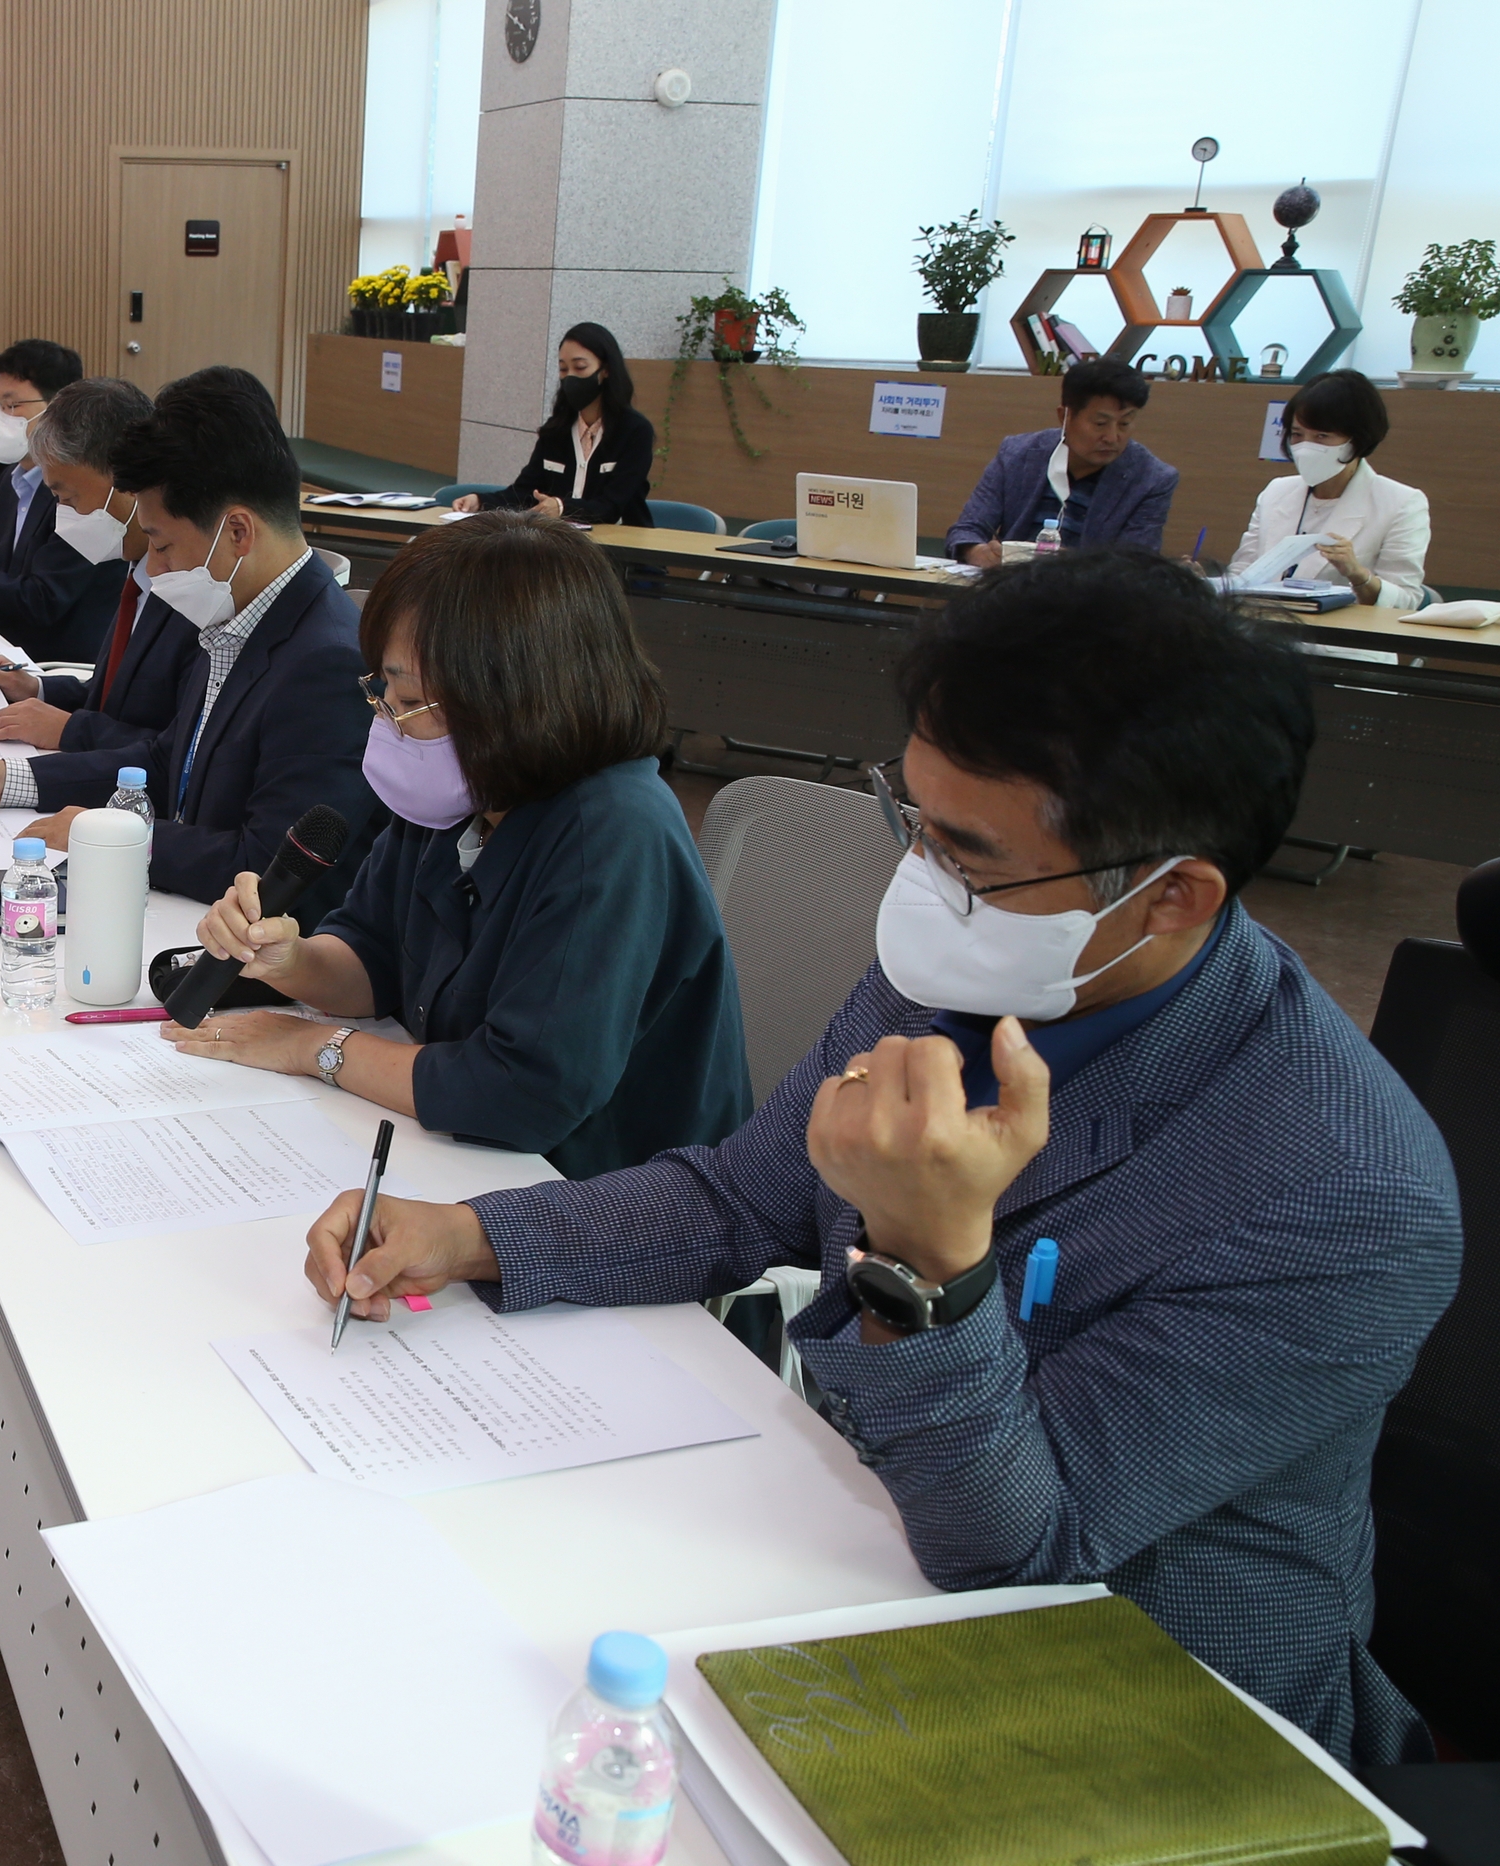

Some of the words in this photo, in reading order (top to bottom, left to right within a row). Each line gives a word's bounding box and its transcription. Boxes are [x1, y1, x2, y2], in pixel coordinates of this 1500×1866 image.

[878, 395, 904, 406] 사회적
[906, 396, 940, 408] 거리두기
[810, 494, 833, 505] NEWS
[837, 492, 864, 510] 더원
